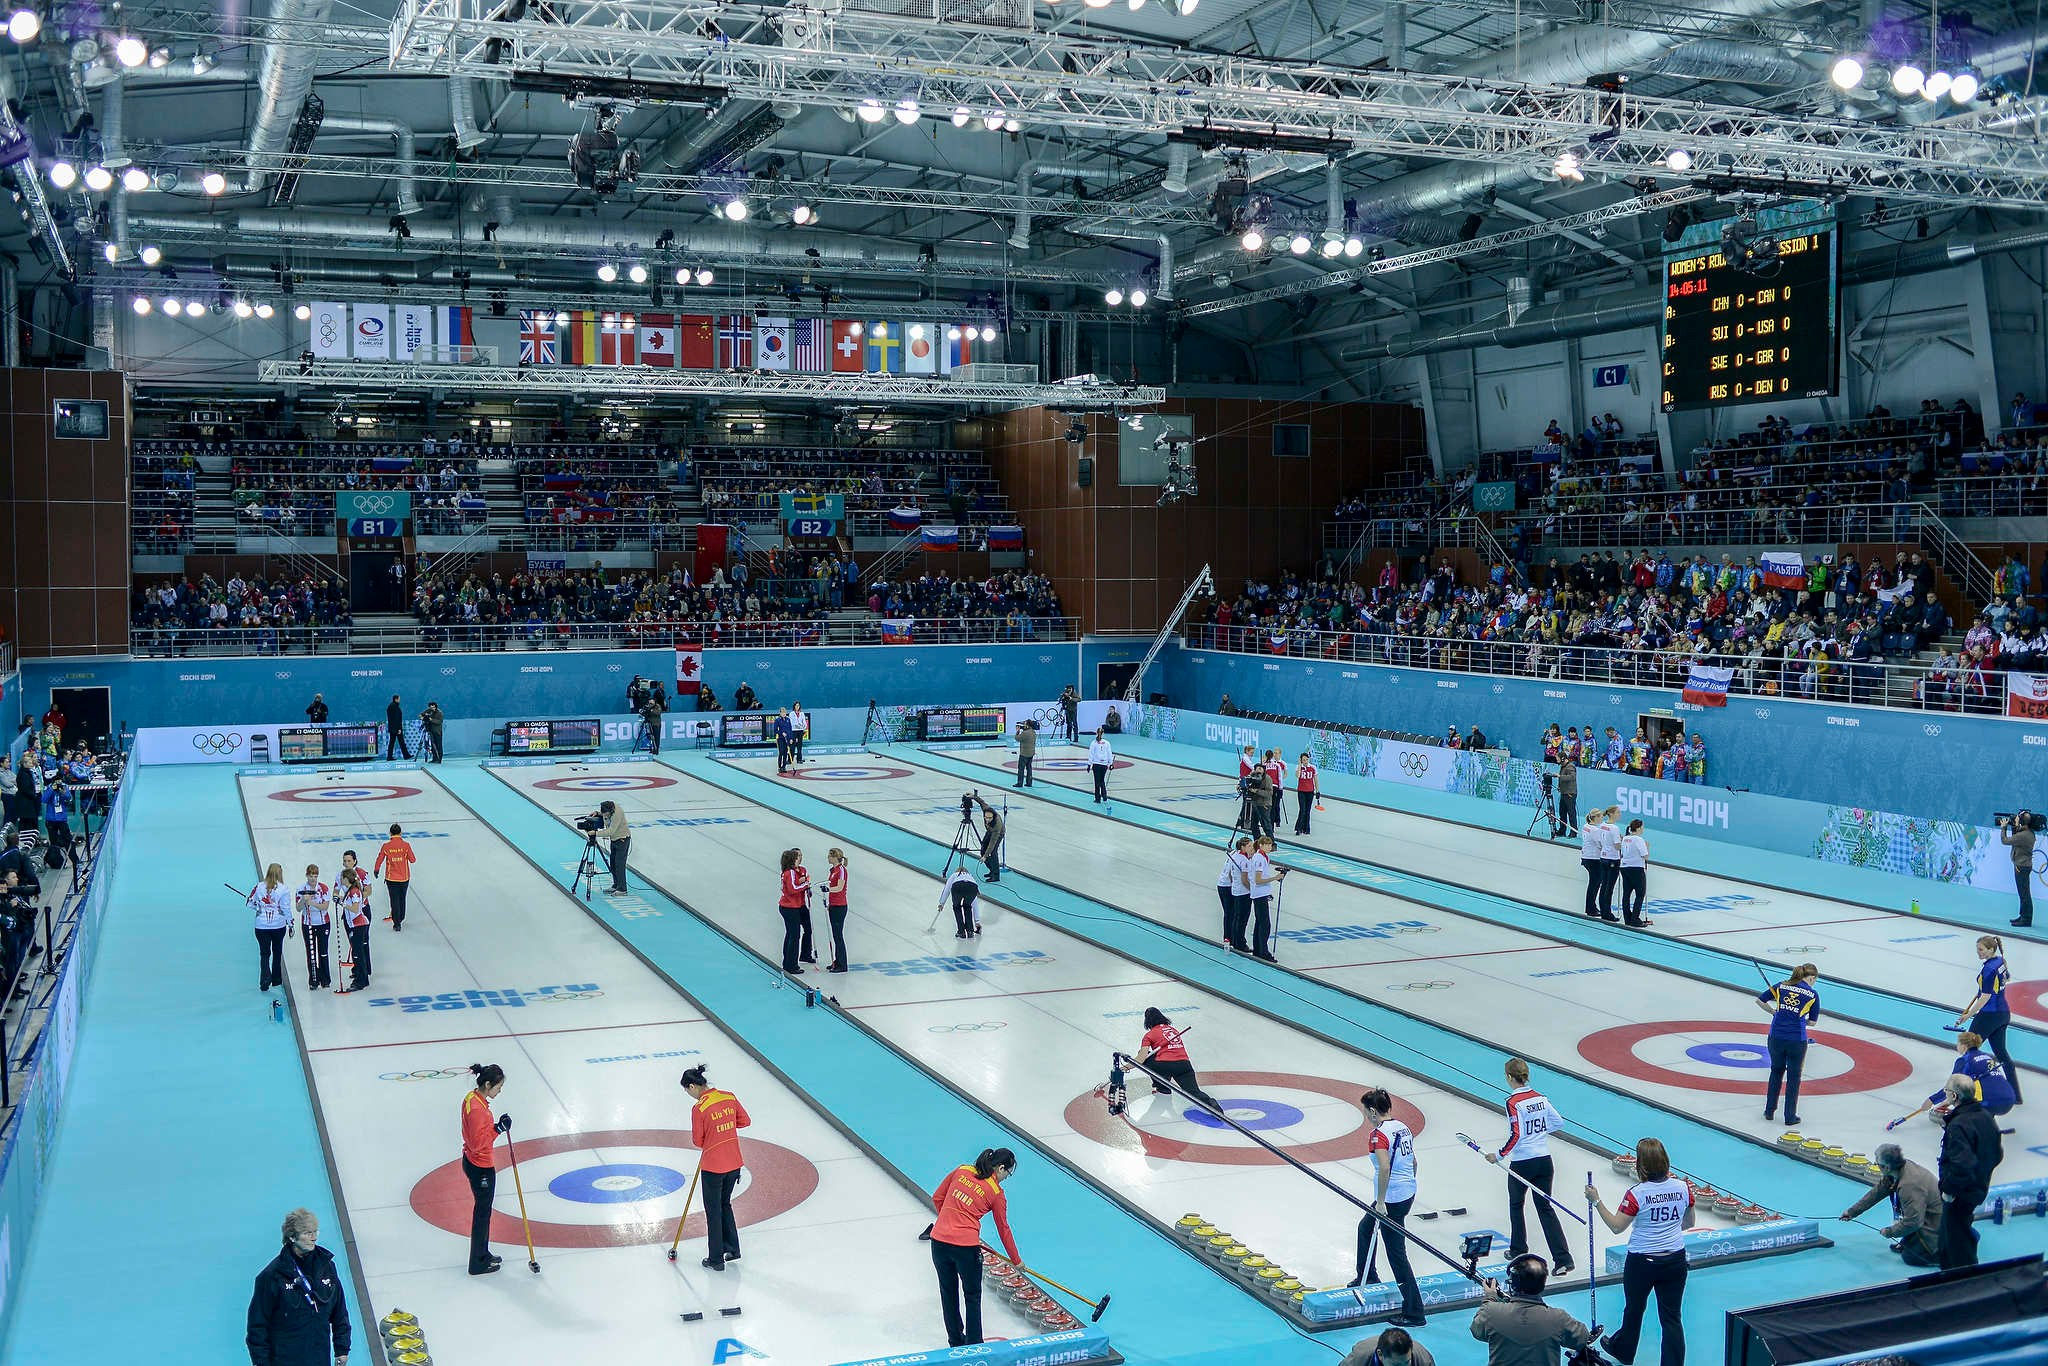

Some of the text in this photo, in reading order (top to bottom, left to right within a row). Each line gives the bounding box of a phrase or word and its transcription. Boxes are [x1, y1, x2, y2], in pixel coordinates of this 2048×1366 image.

[1671, 256, 1705, 276] WOMEN'S
[1812, 234, 1819, 250] 1
[1668, 278, 1708, 297] 14:05:11
[1711, 295, 1729, 312] CHN
[1737, 294, 1744, 308] 0
[1757, 288, 1775, 305] CAN
[1783, 286, 1791, 300] 0
[1711, 325, 1729, 341] SUI
[1736, 324, 1743, 338] 0
[1757, 319, 1775, 334] USA
[1783, 316, 1790, 331] 0
[1711, 355, 1728, 371] SWE
[1736, 353, 1743, 367] 0
[1756, 349, 1774, 365] GBR
[1782, 347, 1790, 361] 0
[1603, 368, 1617, 384] C1
[1710, 384, 1728, 400] RUS
[1735, 382, 1742, 396] 0
[1755, 379, 1773, 395] DEN
[1781, 376, 1789, 391] 0
[363, 521, 384, 534] B1
[802, 521, 822, 534] B2
[604, 721, 666, 741] SOCI
[1206, 722, 1259, 749] СОЧИ 2014
[2023, 735, 2047, 746] SOCHI
[1616, 786, 1729, 829] SOCHI 2014
[1268, 920, 1428, 939] ochi.ru
[367, 983, 600, 1007] sochi.ru
[401, 996, 526, 1013] 2014
[1780, 1003, 1800, 1014] SWE
[585, 1049, 701, 1064] SOCHI 2014
[711, 1112, 722, 1121] Liu
[1525, 1116, 1547, 1135] USA
[716, 1121, 735, 1133] CHINA
[958, 1174, 986, 1199] Zhou Yan
[952, 1189, 974, 1207] CHINA
[1645, 1192, 1683, 1205] McCORMICK
[1650, 1205, 1681, 1222] USA
[1010, 1331, 1086, 1349] SOCHI 2014
[890, 1353, 928, 1365] СОЧИ
